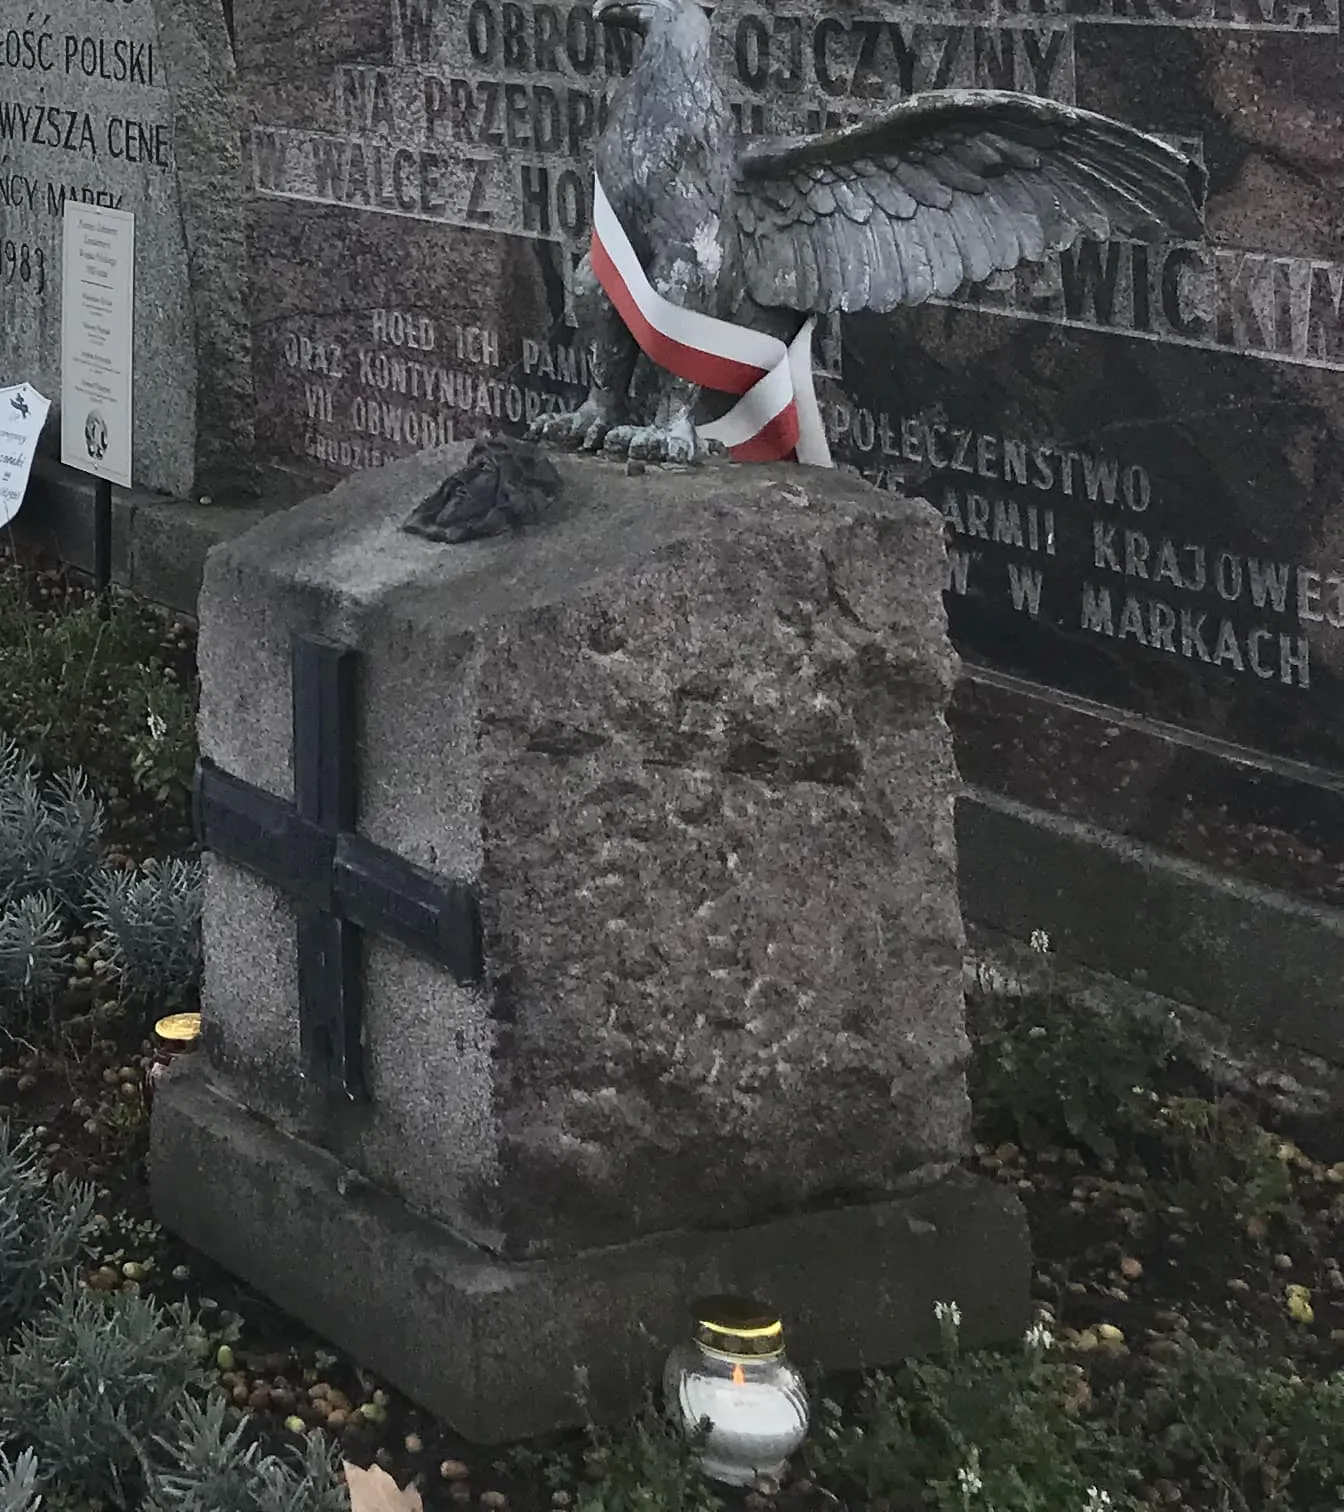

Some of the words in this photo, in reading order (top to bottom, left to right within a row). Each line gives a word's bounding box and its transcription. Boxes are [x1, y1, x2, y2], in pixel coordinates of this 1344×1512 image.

[65, 34, 154, 85] POLSKI
[735, 13, 1067, 100] OJCZYZNY
[108, 117, 170, 175] CENĘ
[372, 309, 435, 351] HOŁD
[456, 323, 500, 368] ICH
[284, 333, 343, 379] ORAZ
[941, 491, 1055, 557] ARMII
[1009, 561, 1043, 616] W
[1081, 580, 1310, 689] MARKACH
